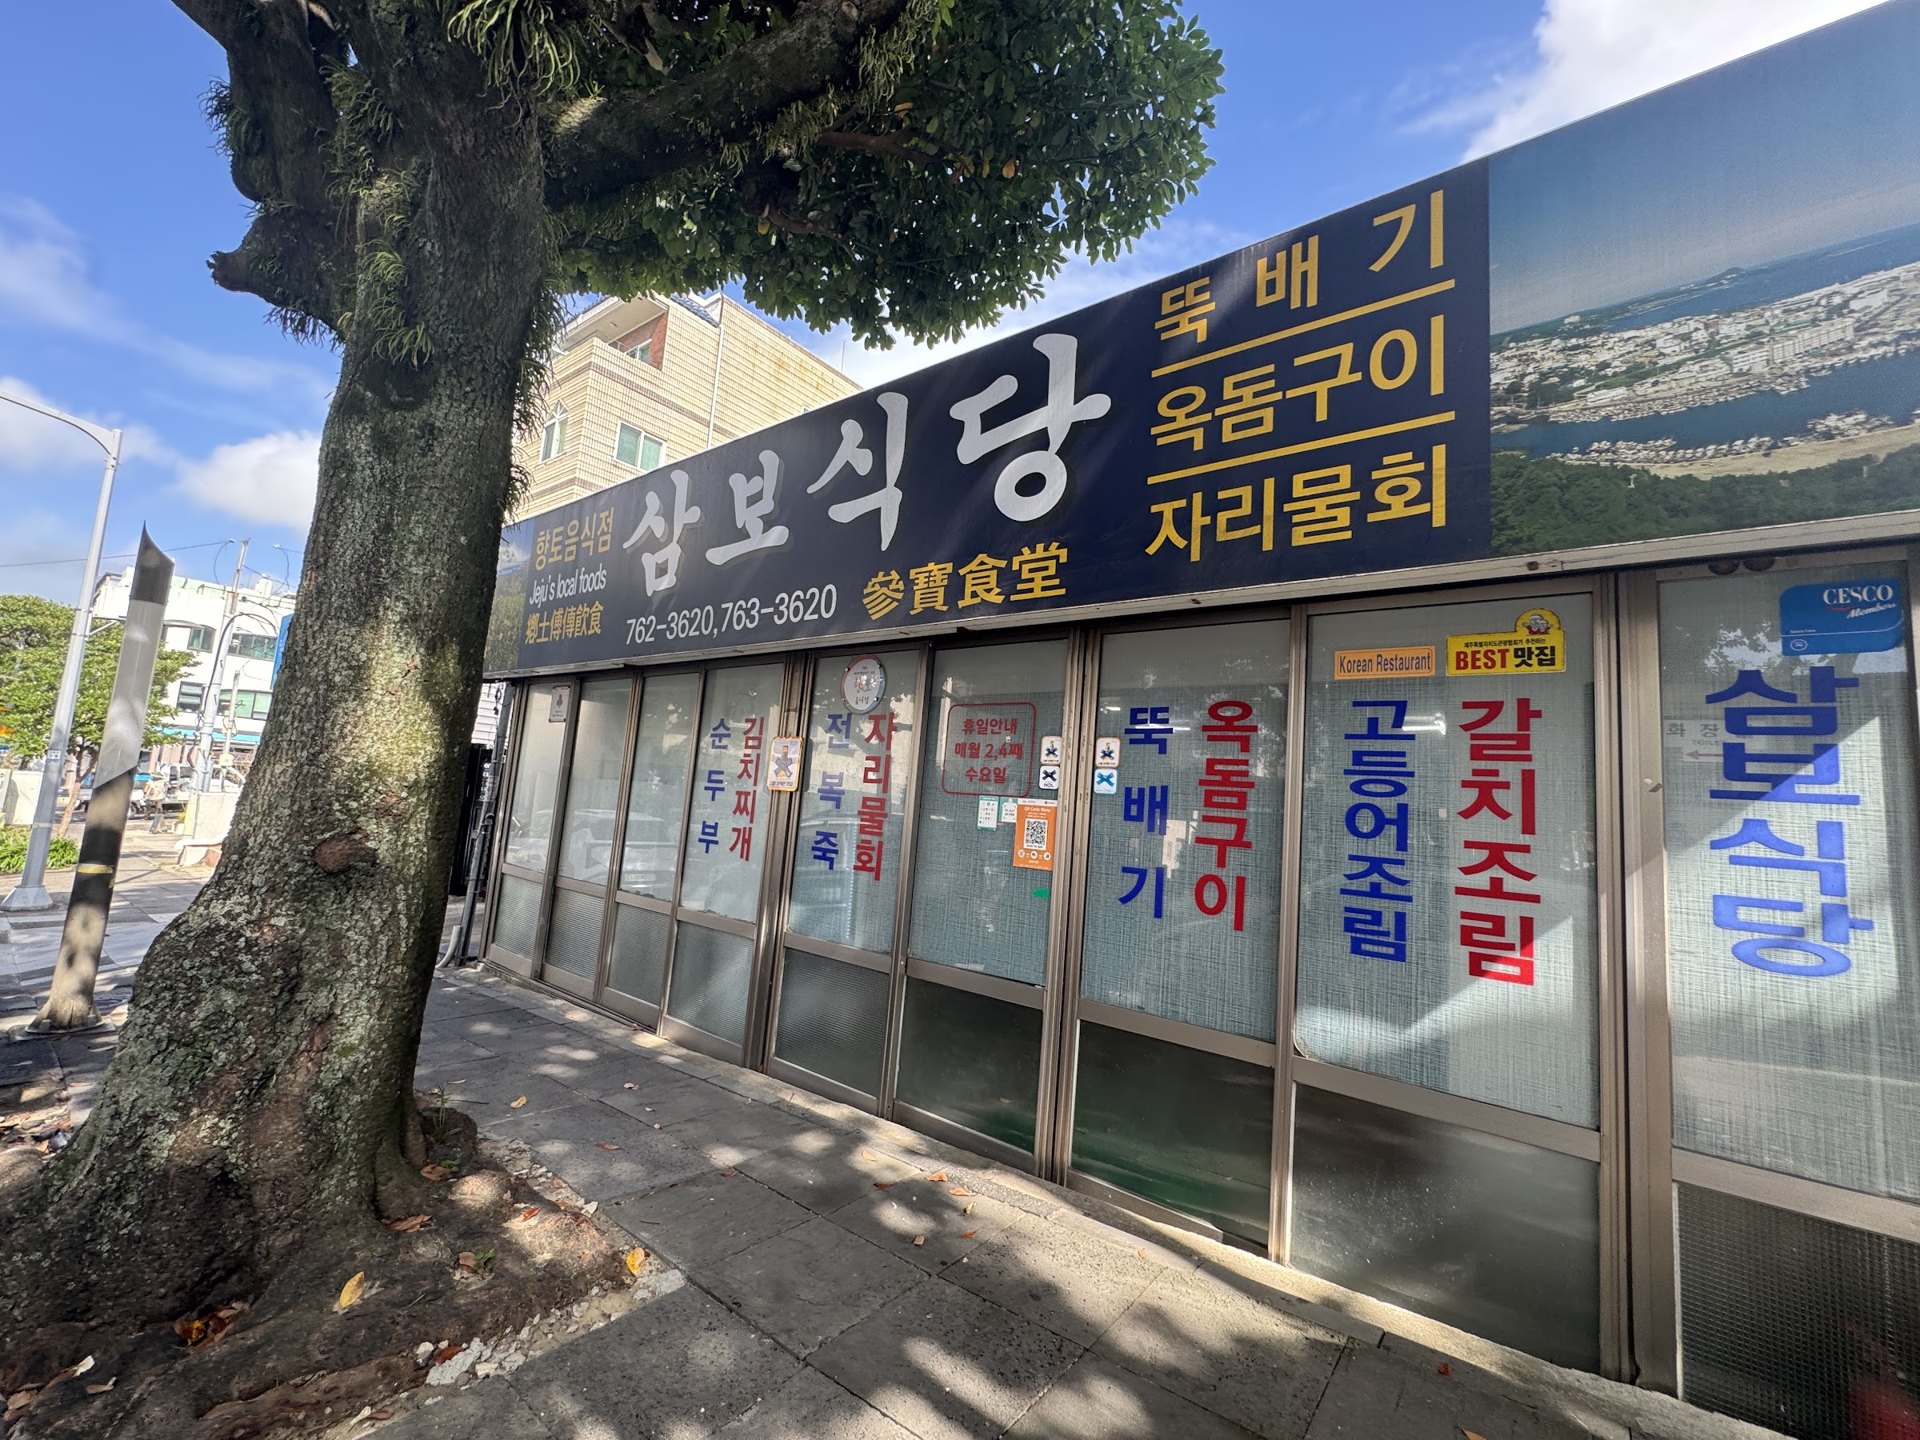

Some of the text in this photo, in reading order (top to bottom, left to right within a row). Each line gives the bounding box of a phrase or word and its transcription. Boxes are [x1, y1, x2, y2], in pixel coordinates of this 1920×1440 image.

[1154, 189, 1444, 343] 뚝배기
[1150, 314, 1444, 451] 옥돔구이
[623, 333, 1111, 597] 삼보식당
[1145, 444, 1446, 562] 자리물회
[529, 562, 607, 608] Jeju's local foods
[536, 508, 615, 571] 향토음식점
[1823, 585, 1893, 605] CESCO
[626, 584, 838, 645] 762-3620,763-3620
[1339, 651, 1431, 674] Korean Restaurant
[1456, 645, 1556, 671] BEST 맛집
[698, 718, 731, 853] 순두부
[729, 716, 764, 861] 김치찌개
[811, 712, 852, 870] 전복죽
[954, 741, 1024, 760] 매월 2,4째
[962, 718, 1018, 735] 휴일안내
[965, 766, 1006, 784] 수요일
[853, 711, 897, 881] 자리물회
[1118, 706, 1173, 918] 뚝배기
[1194, 700, 1258, 931] 옥돔구이
[1340, 700, 1416, 963] 고등어조림
[1454, 698, 1543, 986] 갈치조림
[1705, 666, 1874, 977] 삼보식당
